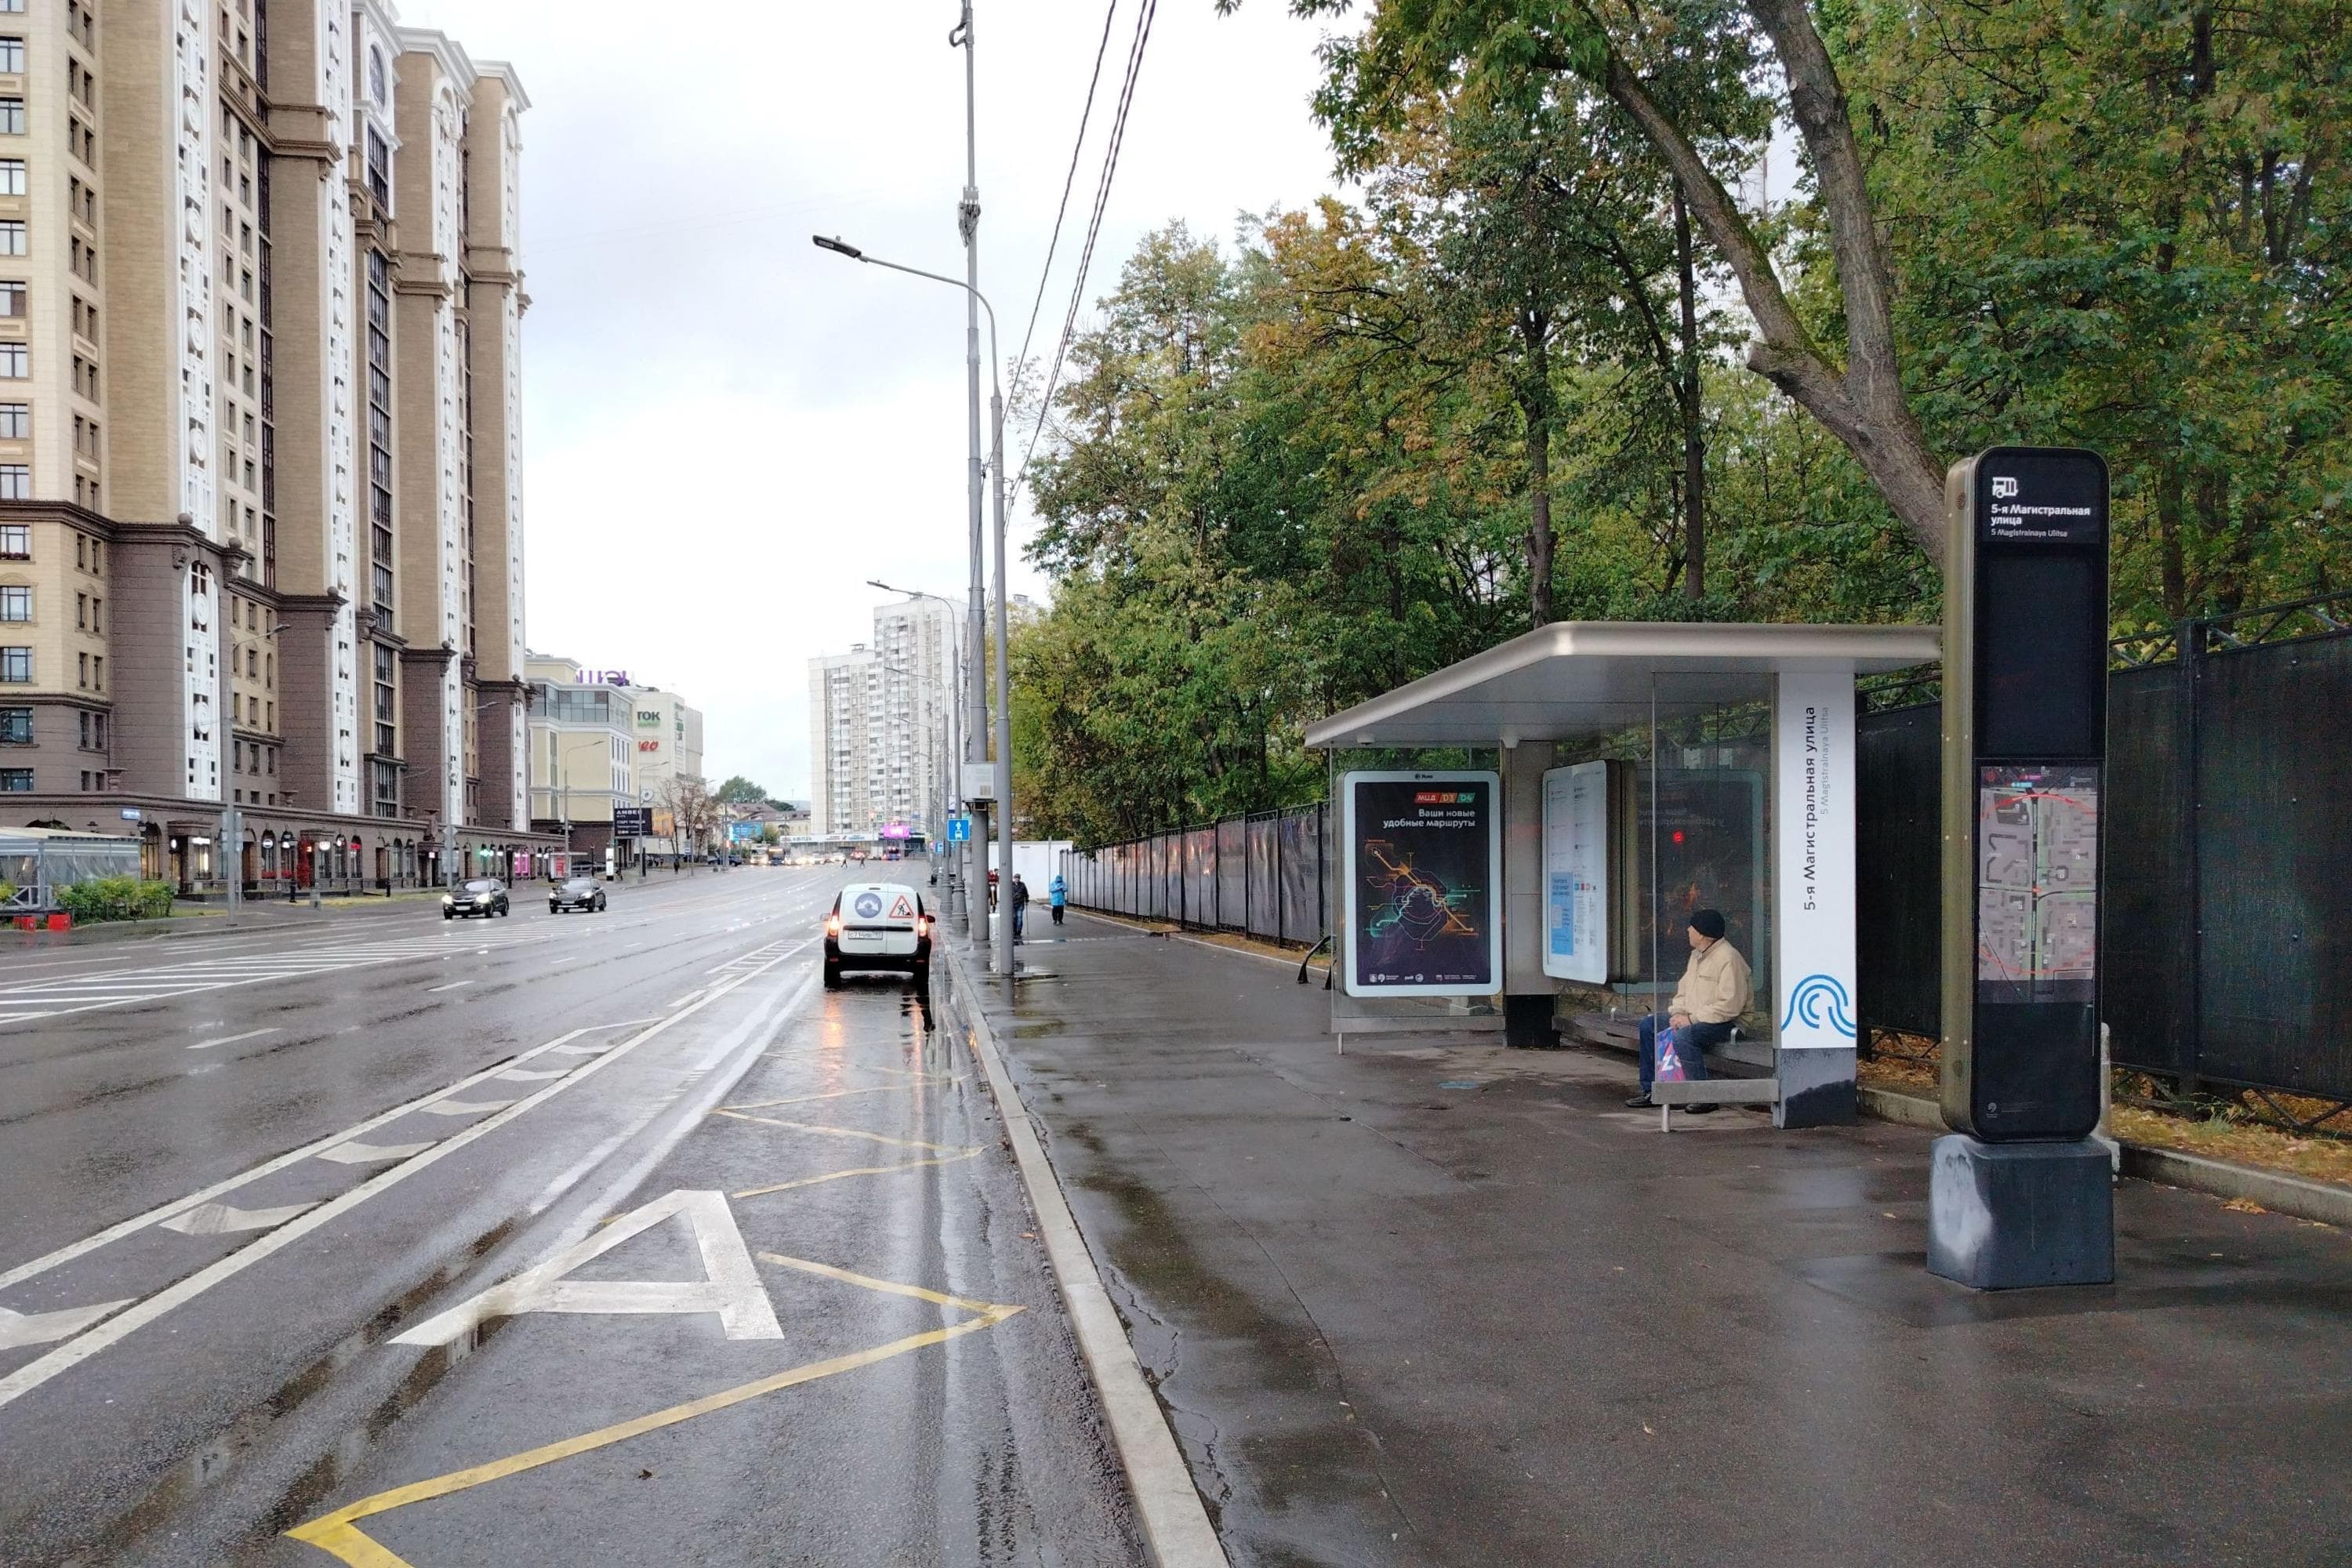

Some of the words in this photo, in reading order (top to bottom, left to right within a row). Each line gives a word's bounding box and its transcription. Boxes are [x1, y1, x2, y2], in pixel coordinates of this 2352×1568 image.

[1991, 504, 2008, 514] 5-я
[2010, 504, 2091, 517] Магистральная
[1991, 517, 2022, 526] улица
[1806, 706, 1817, 753] улица
[1418, 808, 1444, 818] Ваши
[1804, 757, 1817, 880] Магистральная
[1383, 818, 1425, 829] удобные
[1426, 819, 1475, 829] маршруты
[1804, 885, 1816, 910] 5-я
